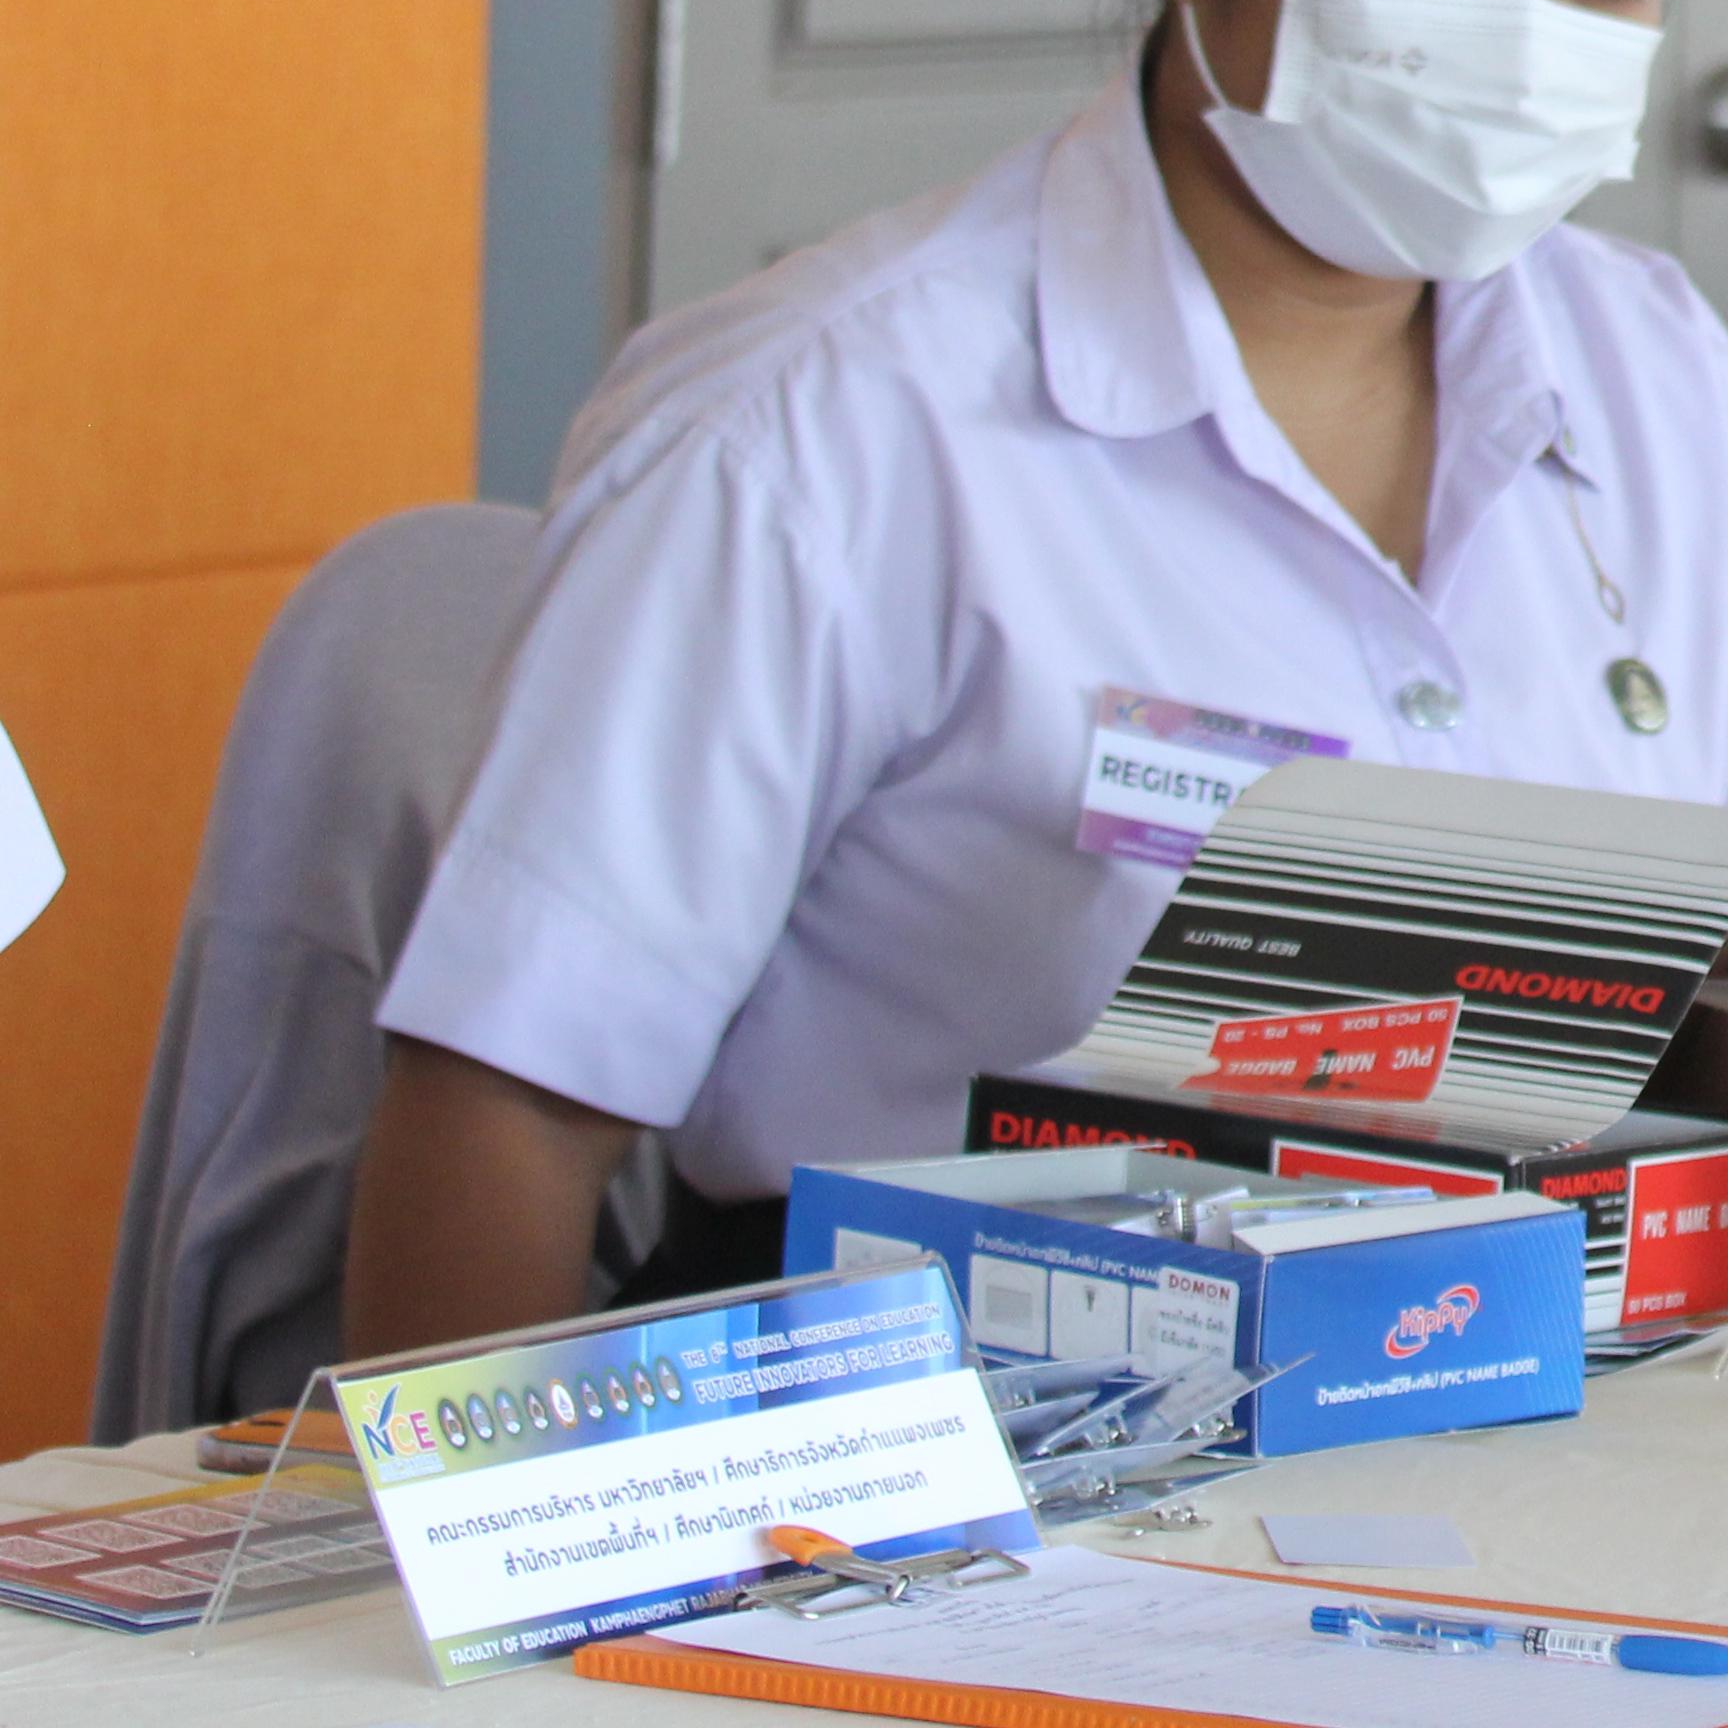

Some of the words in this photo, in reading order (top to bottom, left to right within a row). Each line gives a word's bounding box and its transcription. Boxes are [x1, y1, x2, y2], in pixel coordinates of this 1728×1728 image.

[1099, 755, 1246, 809] REGISTR
[1183, 930, 1254, 951] QUALITY
[1256, 939, 1302, 958] BEST
[1454, 963, 1666, 1015] DIAMOND
[1342, 1015, 1381, 1032] BOX
[1386, 1011, 1421, 1027] PCS
[1227, 1058, 1298, 1077] BADGE
[1312, 1051, 1377, 1075] NAME
[1392, 1045, 1436, 1071] PVC
[1540, 1168, 1627, 1200] DIAMOND
[1642, 1209, 1668, 1240] PVC
[1675, 1204, 1712, 1236] NAME
[1168, 1274, 1231, 1301] DOMON
[733, 1332, 791, 1359] NATIONAL
[790, 1318, 863, 1347] CONFERENCE
[880, 1303, 942, 1329] EDUCATION
[694, 1371, 756, 1403] FUTURE
[753, 1352, 848, 1392] INNOVATORS
[847, 1347, 881, 1373] FOR
[880, 1332, 956, 1366] LEARNING
[362, 1411, 437, 1460] NCE
[427, 1493, 595, 1545] คณะกรรมการบริหาร
[599, 1466, 707, 1509] มหาวิทยาลัยฯ
[504, 1516, 659, 1577] สำนักงานเขตพื้นที่ฯ
[676, 1495, 775, 1539] ศึกษานิเทศก์
[790, 1468, 928, 1515] หน่วยงานภายนอก
[449, 1639, 501, 1667] FACULTY
[502, 1633, 520, 1654] OF
[520, 1619, 588, 1650] EDUCATION
[589, 1597, 691, 1634] KAMPHAENGPHET
